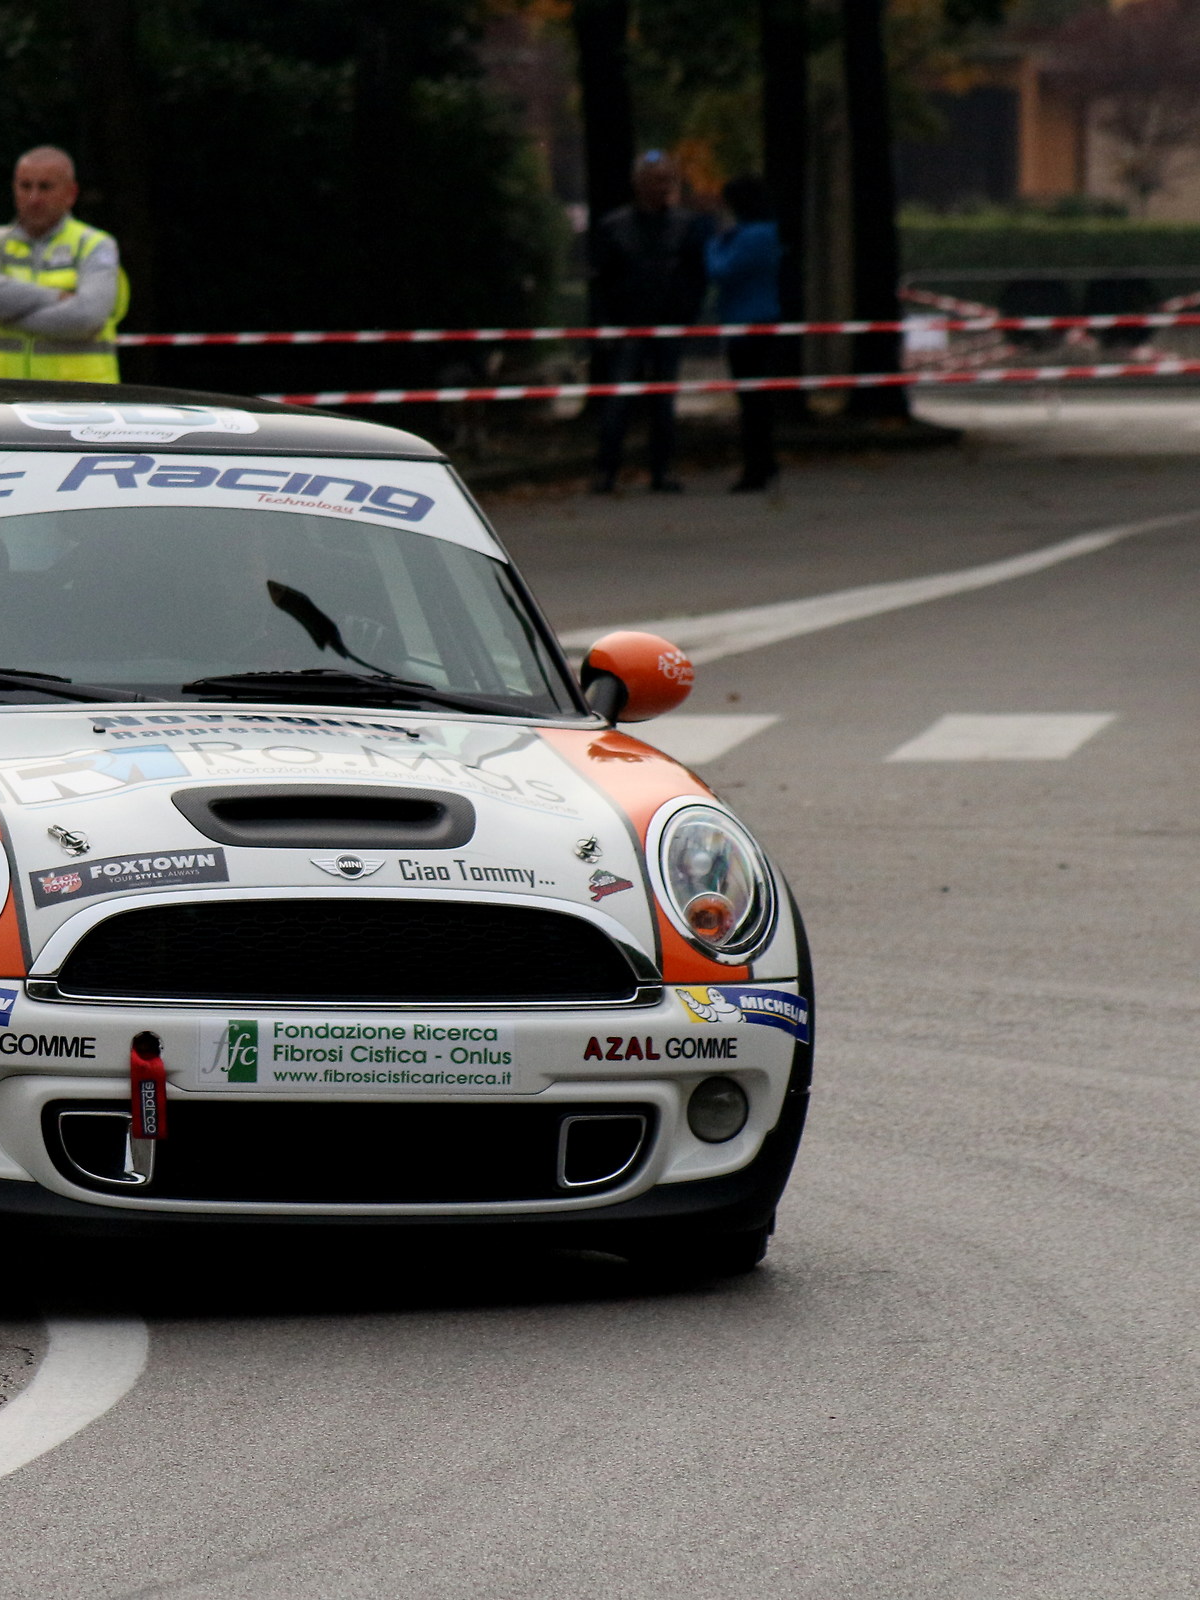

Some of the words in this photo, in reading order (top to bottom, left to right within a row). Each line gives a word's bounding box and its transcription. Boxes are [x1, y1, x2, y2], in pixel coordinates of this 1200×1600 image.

[79, 426, 176, 440] Engineering
[56, 455, 436, 523] Racing
[256, 493, 355, 514] Technology
[90, 853, 217, 879] FOXTOWN
[338, 860, 363, 870] MINI
[399, 858, 450, 882] Ciao
[453, 859, 556, 888] Tommy...
[109, 875, 133, 884] YOUR
[168, 868, 200, 878] ALWAYS
[739, 995, 808, 1025] MICHELIN
[273, 1022, 405, 1041] Fondazione
[413, 1024, 498, 1042] Ricerca
[273, 1045, 343, 1063] Fibrosi
[351, 1045, 427, 1064] Cistica
[450, 1047, 512, 1065] Onlus
[583, 1036, 661, 1061] AZAL
[665, 1037, 738, 1059] GOMME
[274, 1069, 512, 1085] www.fibrosicisticaricerca.it
[144, 1080, 157, 1135] sparco
